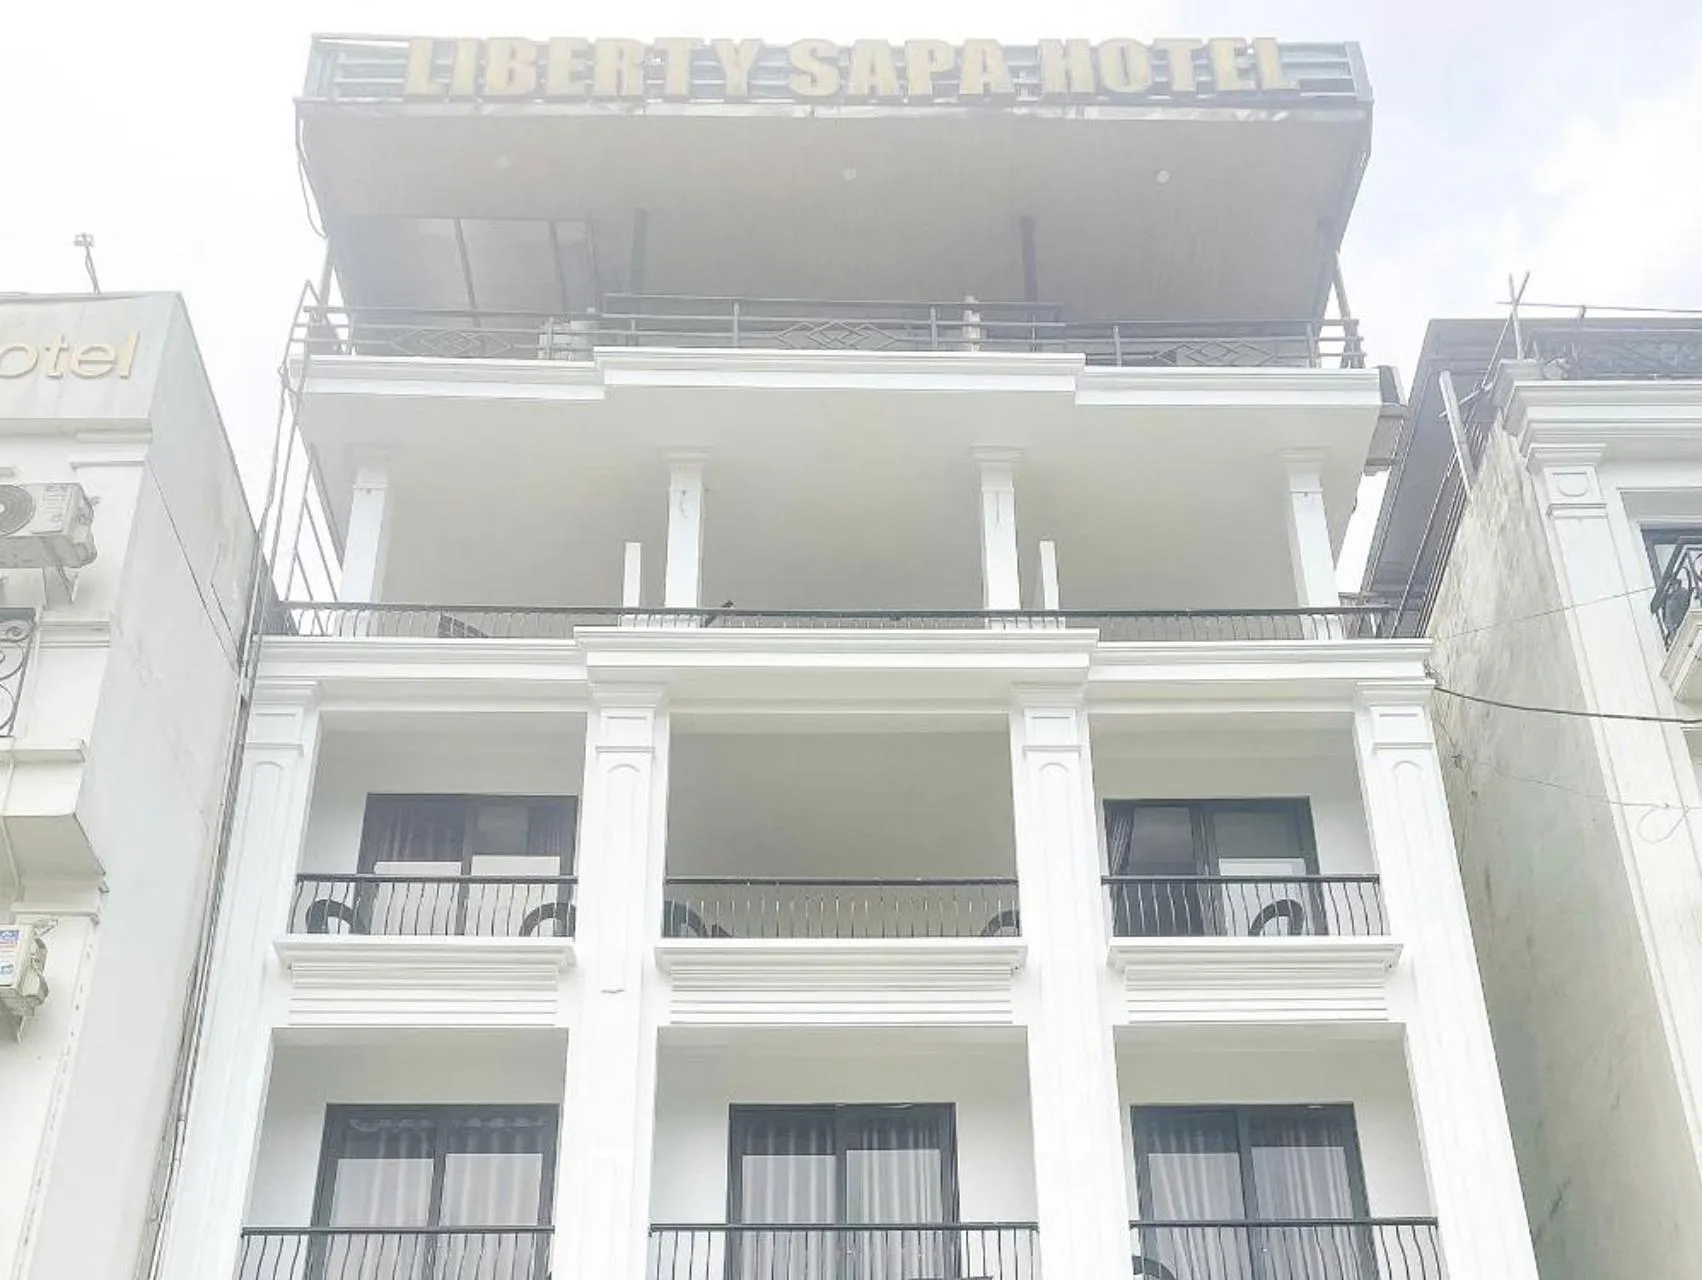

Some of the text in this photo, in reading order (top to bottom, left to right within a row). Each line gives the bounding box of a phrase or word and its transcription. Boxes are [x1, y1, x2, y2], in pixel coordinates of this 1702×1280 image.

[403, 36, 1302, 98] LIBERTY SAPA HOTEL
